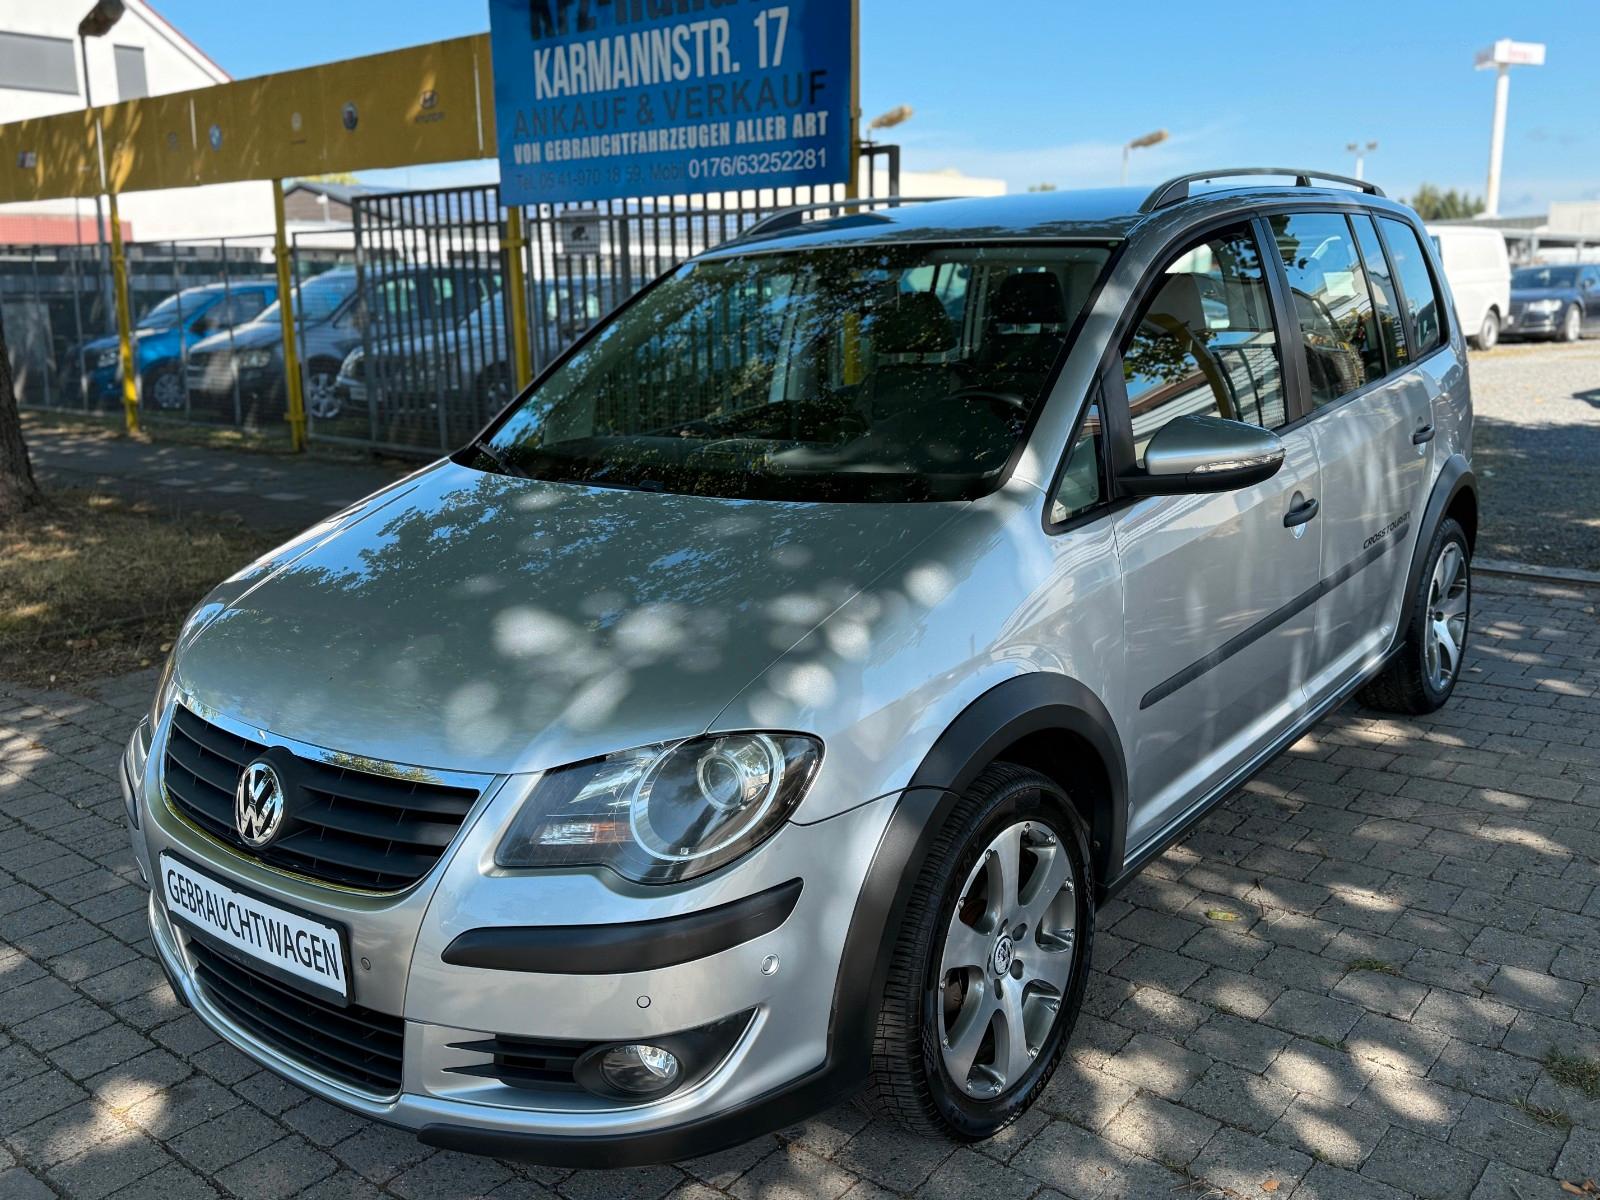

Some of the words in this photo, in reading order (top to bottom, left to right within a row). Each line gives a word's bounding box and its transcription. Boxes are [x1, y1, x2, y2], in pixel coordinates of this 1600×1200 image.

[533, 18, 740, 101] KARMANNSTR.
[753, 6, 790, 70] 17
[513, 95, 627, 140] ANKAUF
[635, 93, 656, 126] &
[662, 69, 828, 122] VERKAUF
[513, 141, 541, 165] VON
[544, 122, 731, 163] GEBRAUCHTFAHRZEUGEN
[735, 114, 787, 144] ALLER
[792, 110, 829, 138] ART
[688, 147, 827, 179] 0176/63252281
[166, 868, 341, 981] GEBRAUCHTWAGEN
